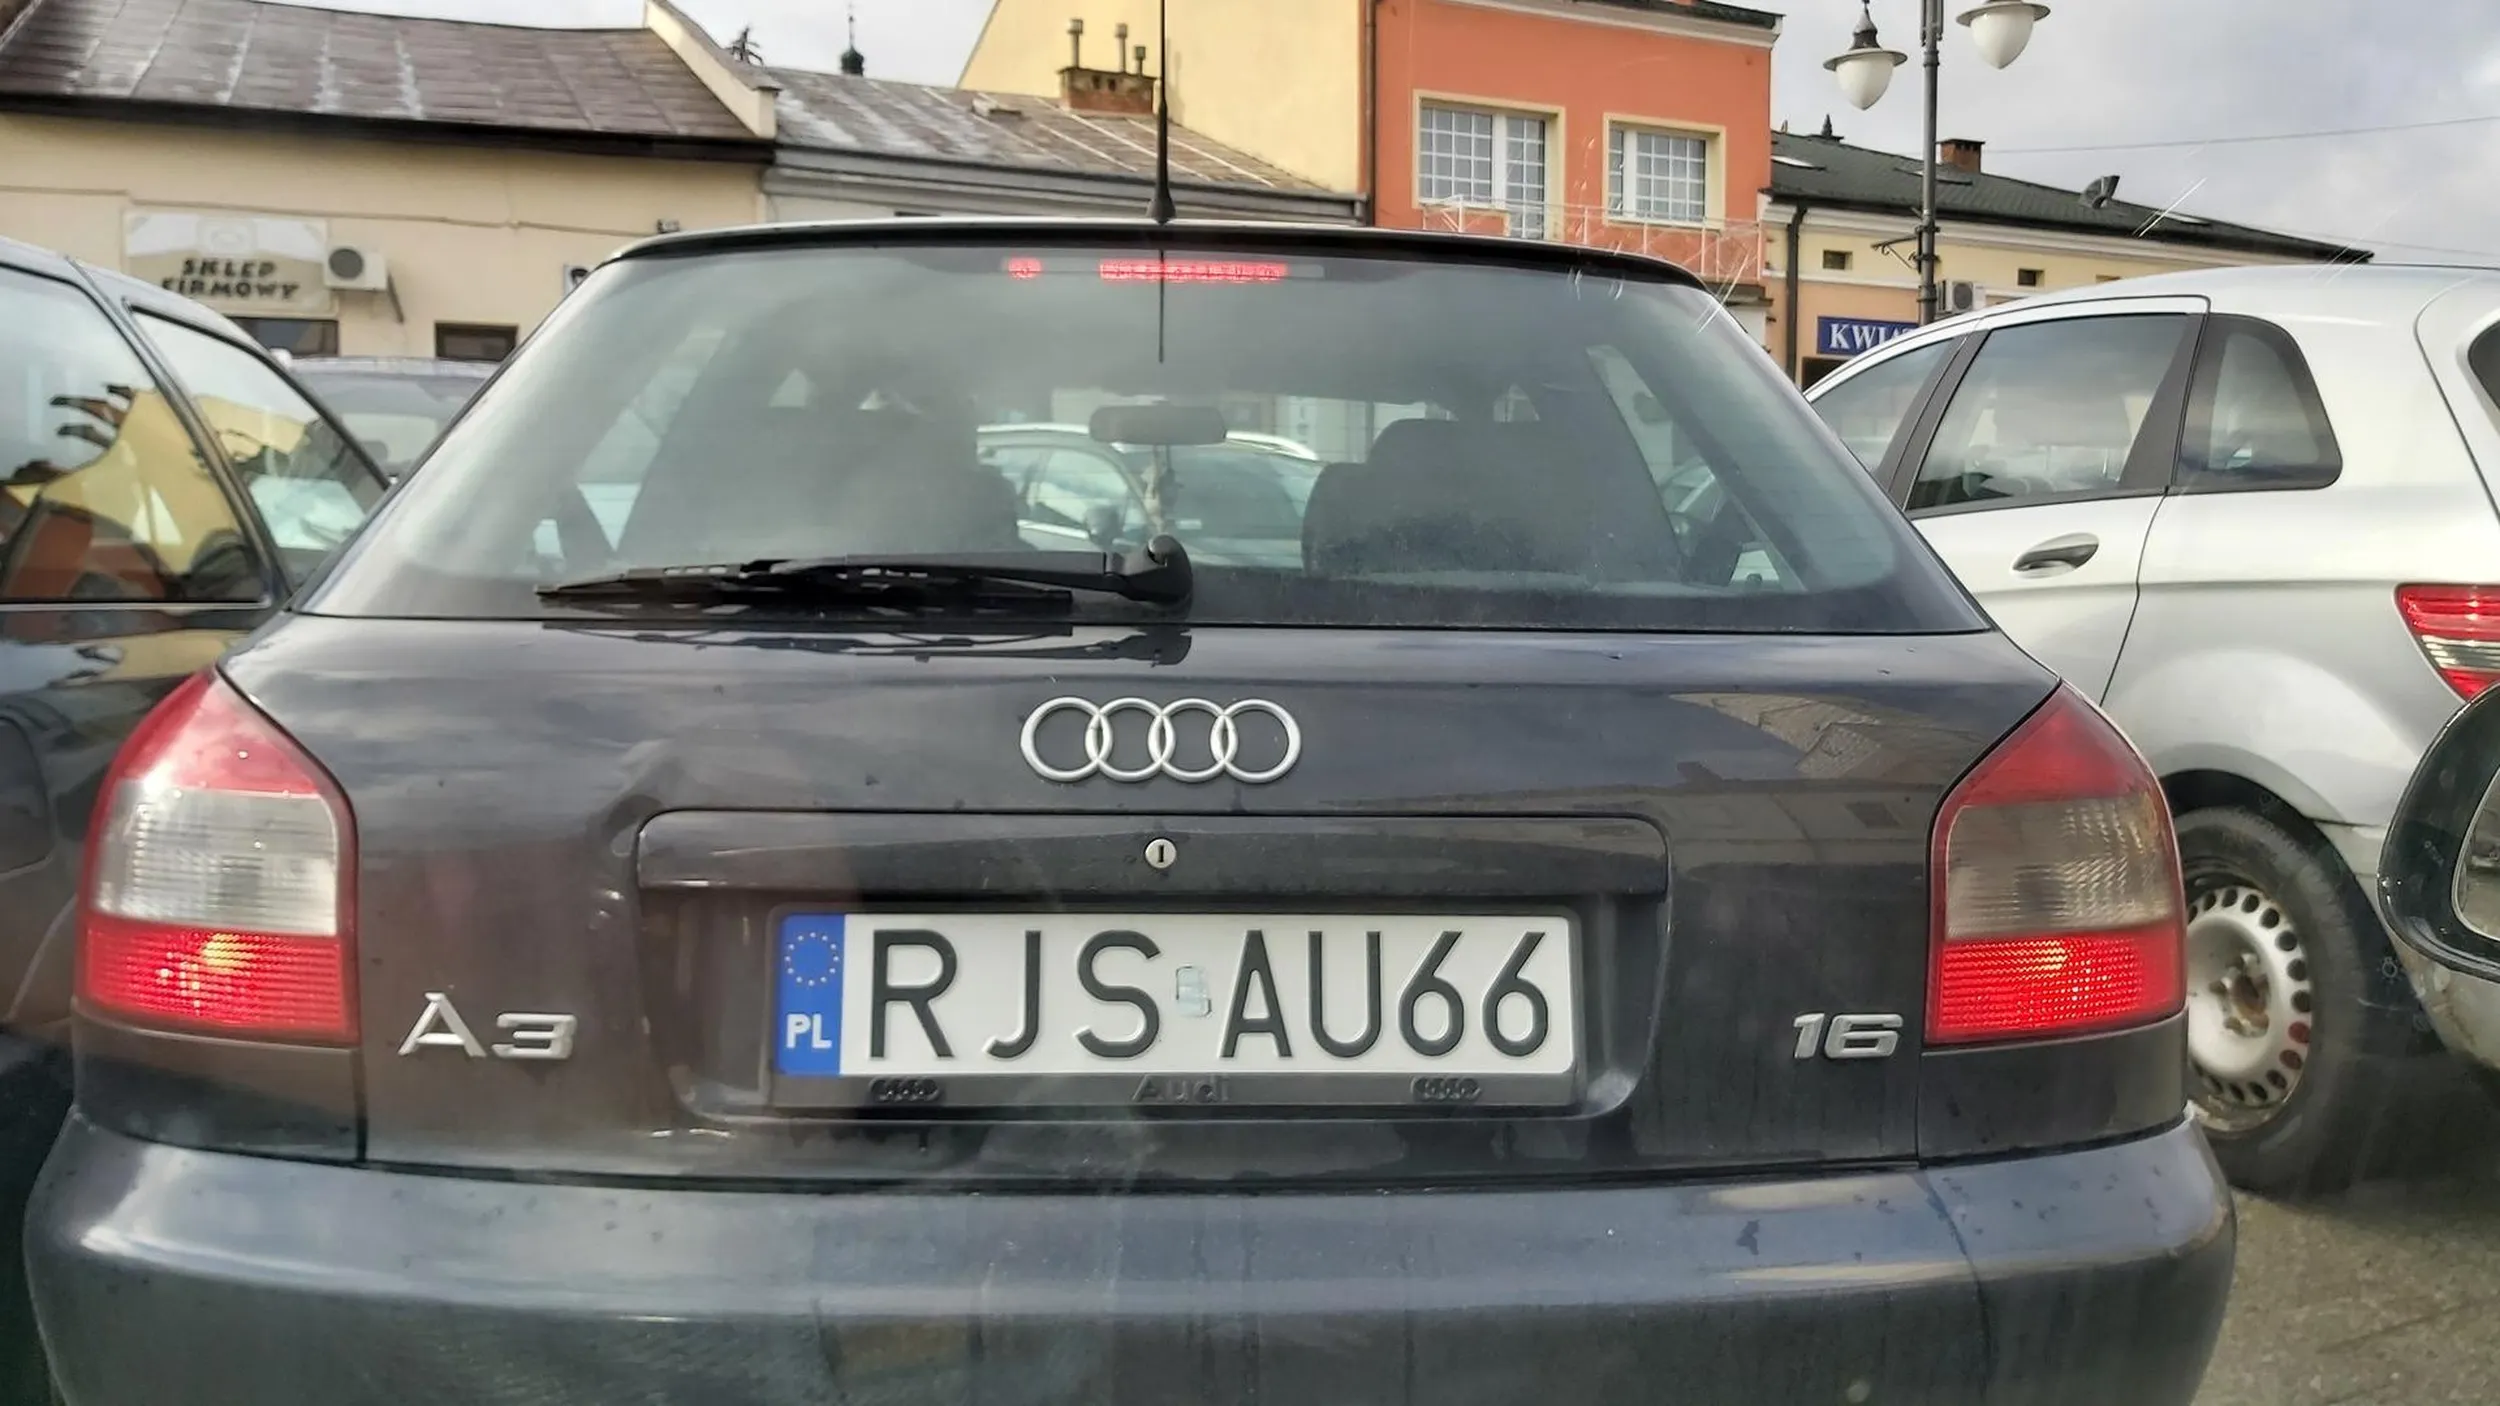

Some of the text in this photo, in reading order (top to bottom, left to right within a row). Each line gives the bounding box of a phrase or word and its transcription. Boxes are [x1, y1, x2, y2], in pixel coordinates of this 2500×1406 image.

[183, 259, 276, 277] SKLEP
[162, 277, 299, 299] FIRMOWY
[869, 929, 1549, 1060] RJS AU66
[398, 992, 577, 1059] A3
[785, 1013, 833, 1050] PL
[1131, 1073, 1230, 1103] Audi
